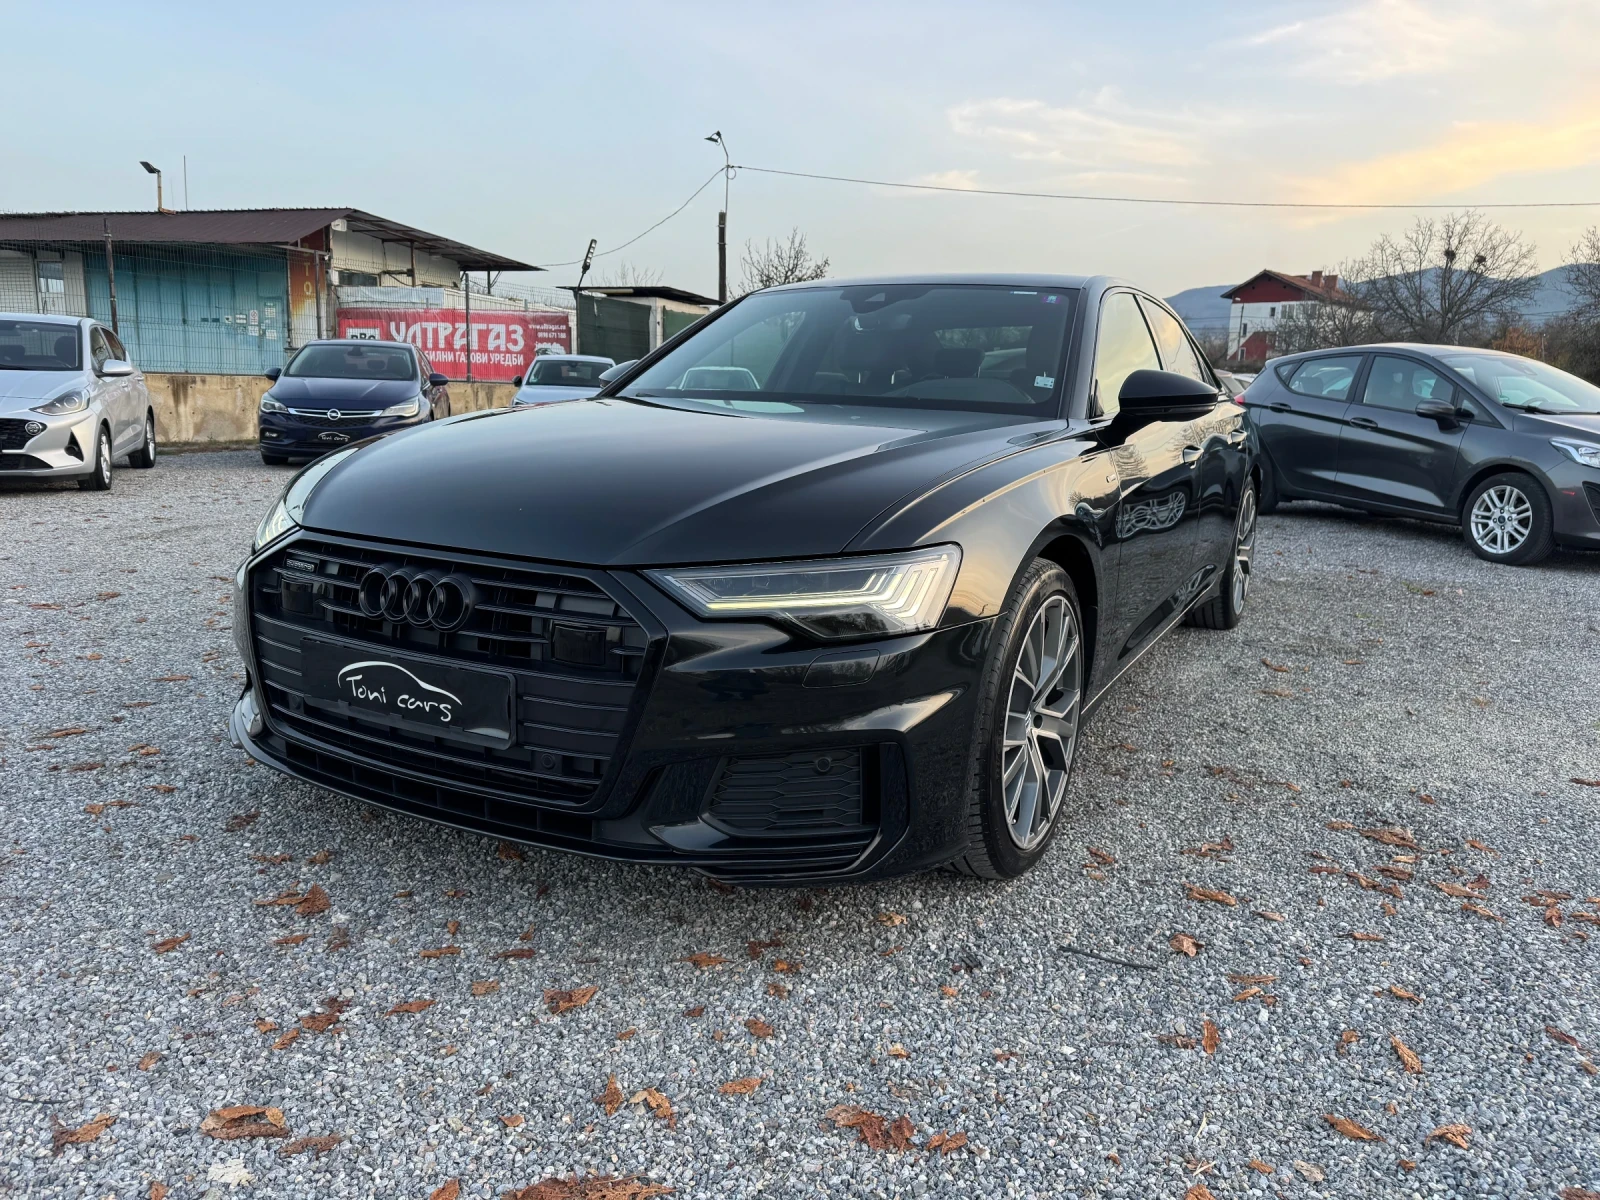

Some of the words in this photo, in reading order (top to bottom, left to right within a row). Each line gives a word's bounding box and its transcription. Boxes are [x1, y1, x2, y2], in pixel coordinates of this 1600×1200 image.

[390, 321, 524, 352] УЛТРАГАЗ
[489, 353, 524, 366] УРЕДБИ
[346, 674, 386, 704] Toni
[397, 694, 452, 722] cars
